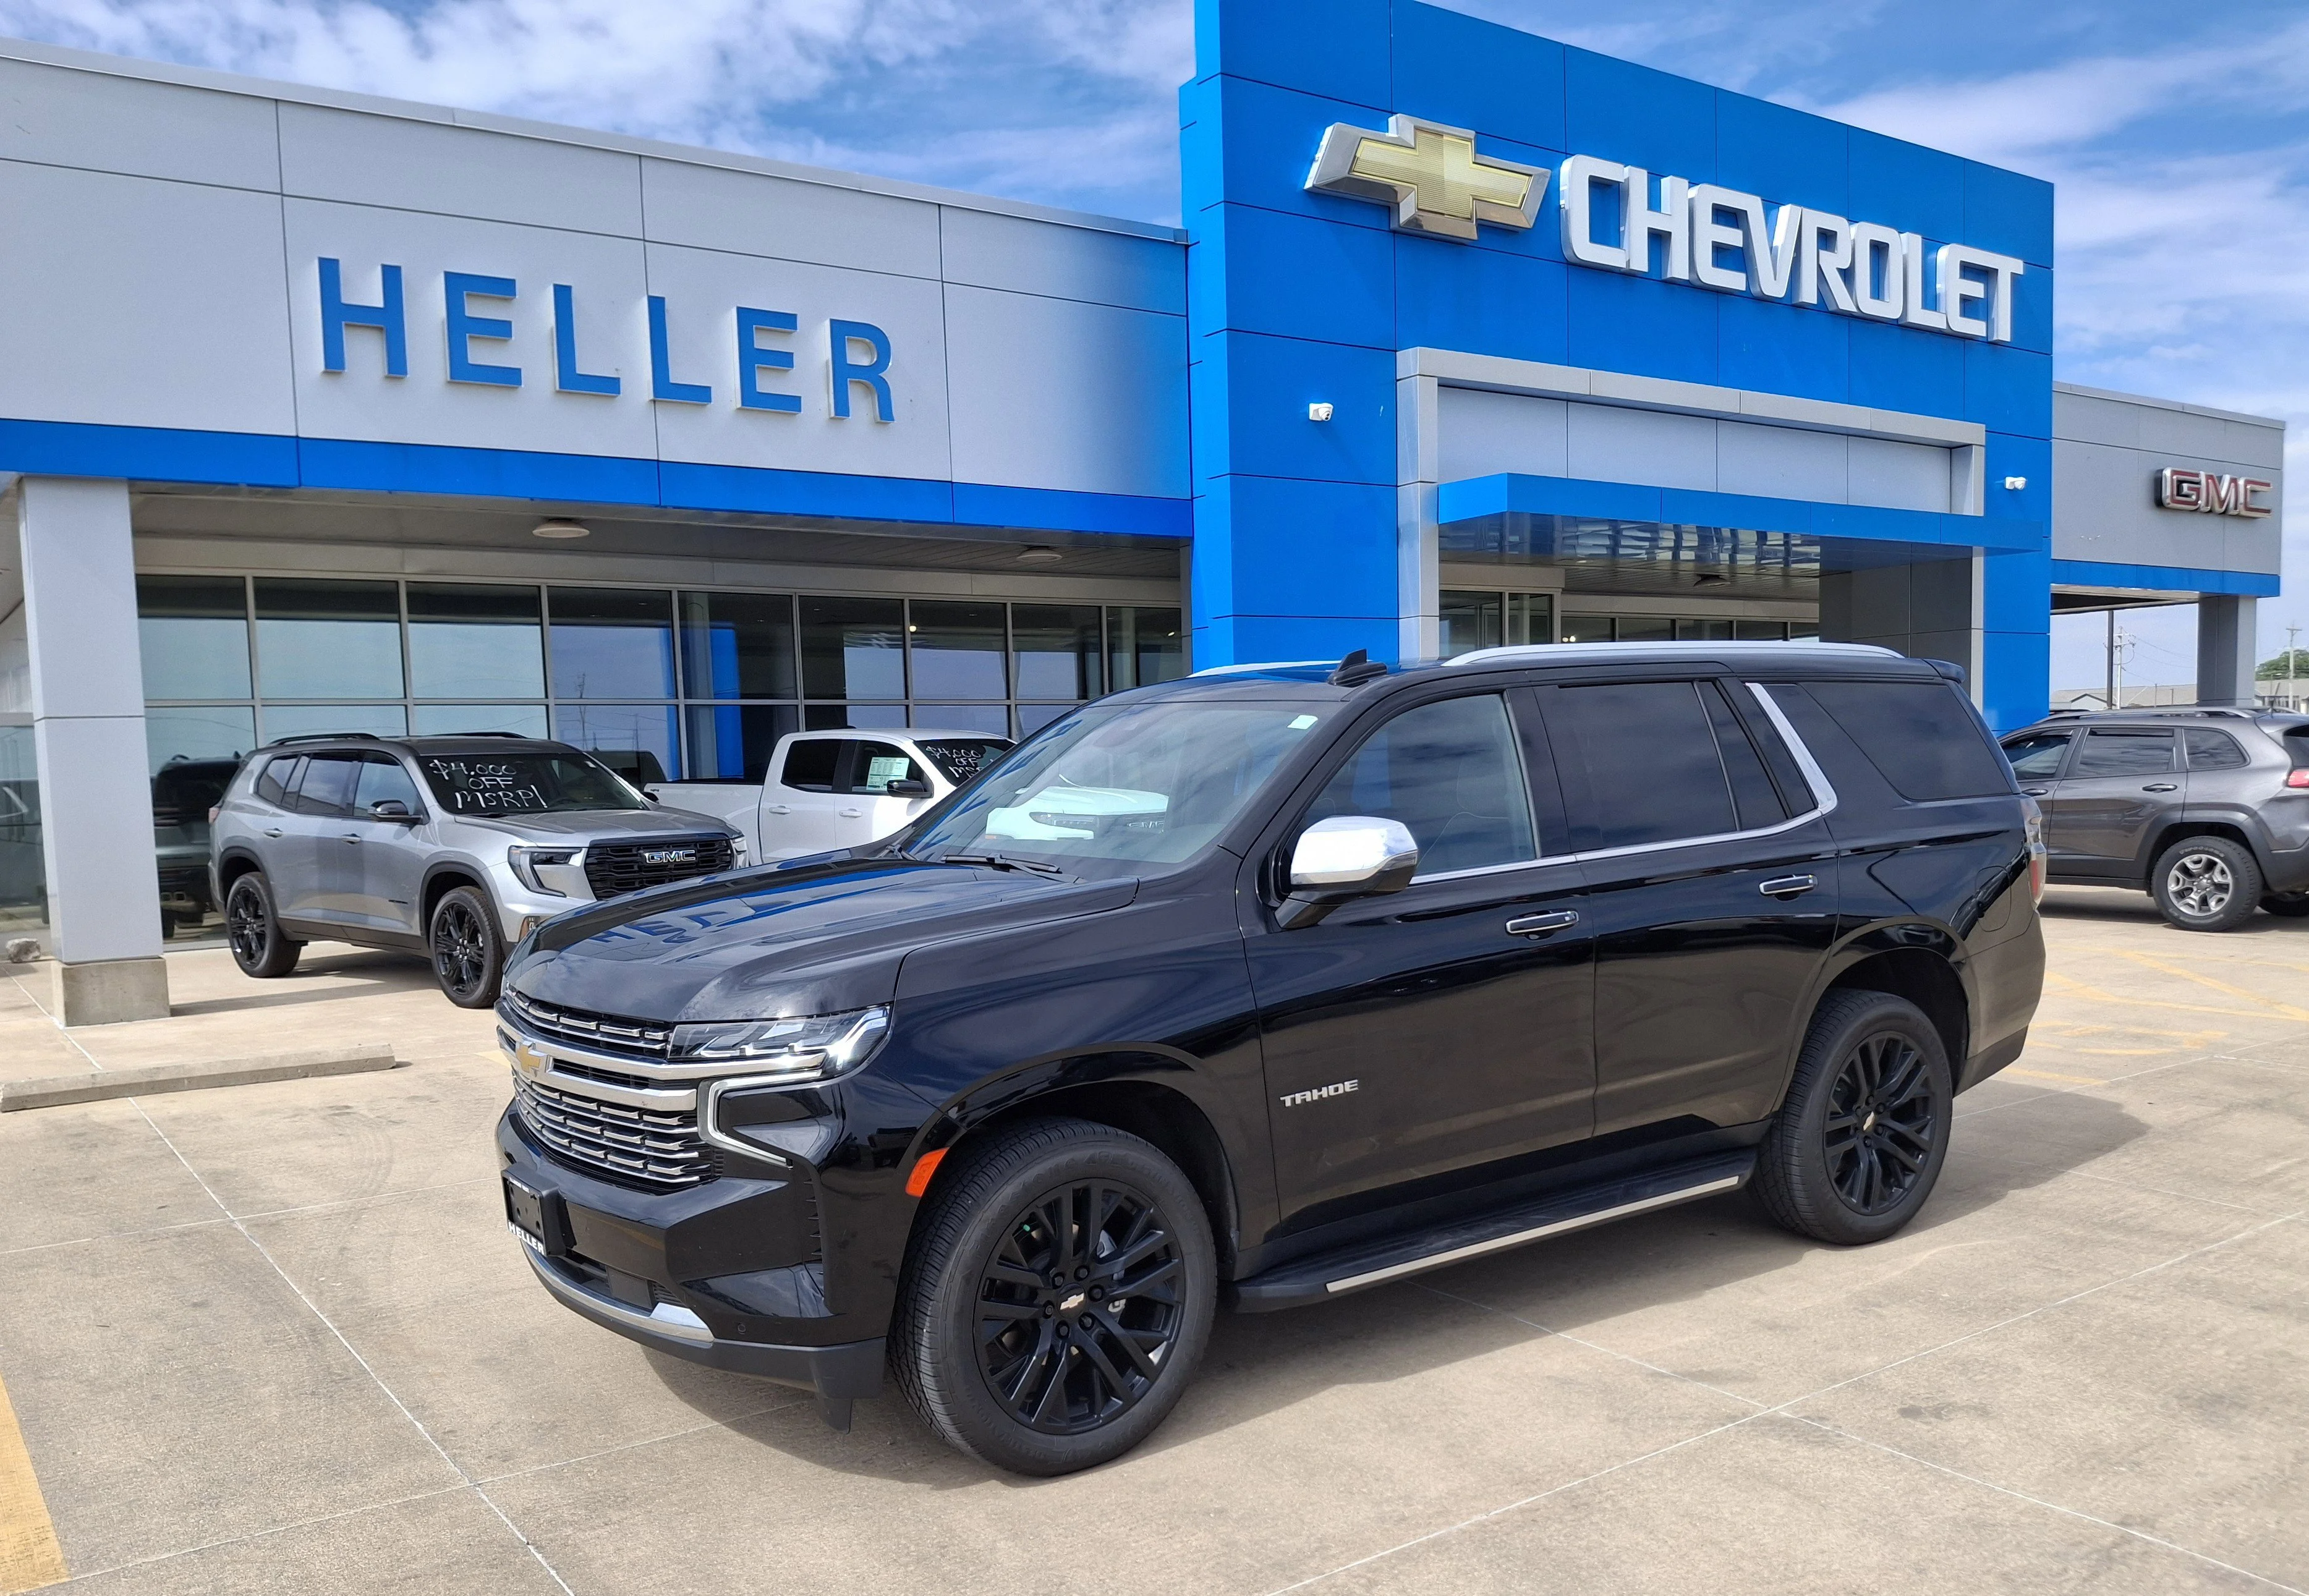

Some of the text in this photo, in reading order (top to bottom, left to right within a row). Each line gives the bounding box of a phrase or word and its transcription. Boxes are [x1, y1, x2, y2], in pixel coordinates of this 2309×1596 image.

[1560, 154, 2023, 342] CHEVROLET
[318, 257, 895, 423] HELLER
[2154, 467, 2273, 518] GMC
[455, 784, 548, 809] MSRP!
[468, 776, 512, 789] OFF
[644, 849, 696, 864] GMC
[1280, 1079, 1359, 1108] TAHOE
[508, 1221, 545, 1255] HELLER
